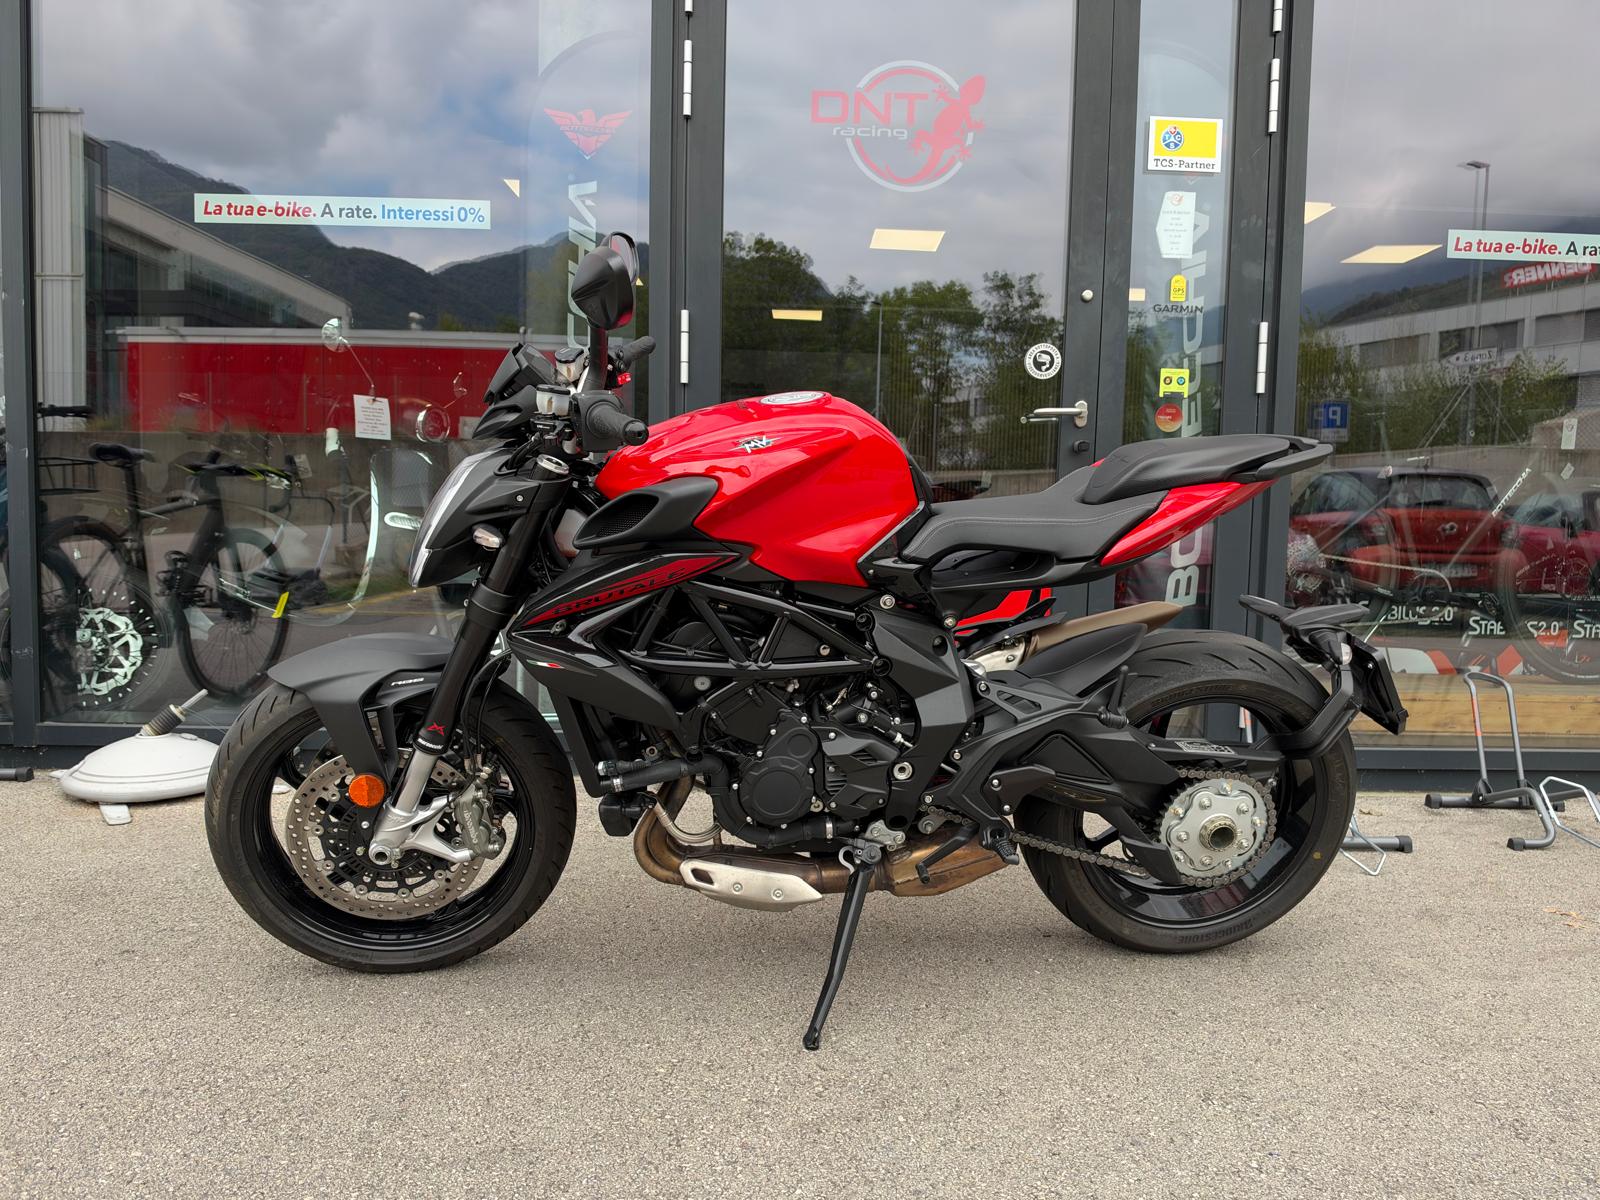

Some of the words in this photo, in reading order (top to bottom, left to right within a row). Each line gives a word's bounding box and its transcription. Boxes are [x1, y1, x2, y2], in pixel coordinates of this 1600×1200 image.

[811, 90, 929, 124] DNT
[832, 125, 908, 140] racing
[1153, 158, 1216, 170] TCS-Partner
[203, 200, 223, 216] La
[226, 201, 254, 217] tua
[257, 200, 317, 218] e-bike.
[320, 203, 334, 218] A
[338, 204, 377, 219] rate.
[381, 204, 454, 222] Interessi
[457, 206, 485, 223] 0%
[1454, 236, 1473, 252] La
[1477, 239, 1503, 253] tua
[1505, 238, 1562, 255] e-bike.
[1565, 240, 1578, 256] A
[1153, 303, 1204, 314] GARMIN
